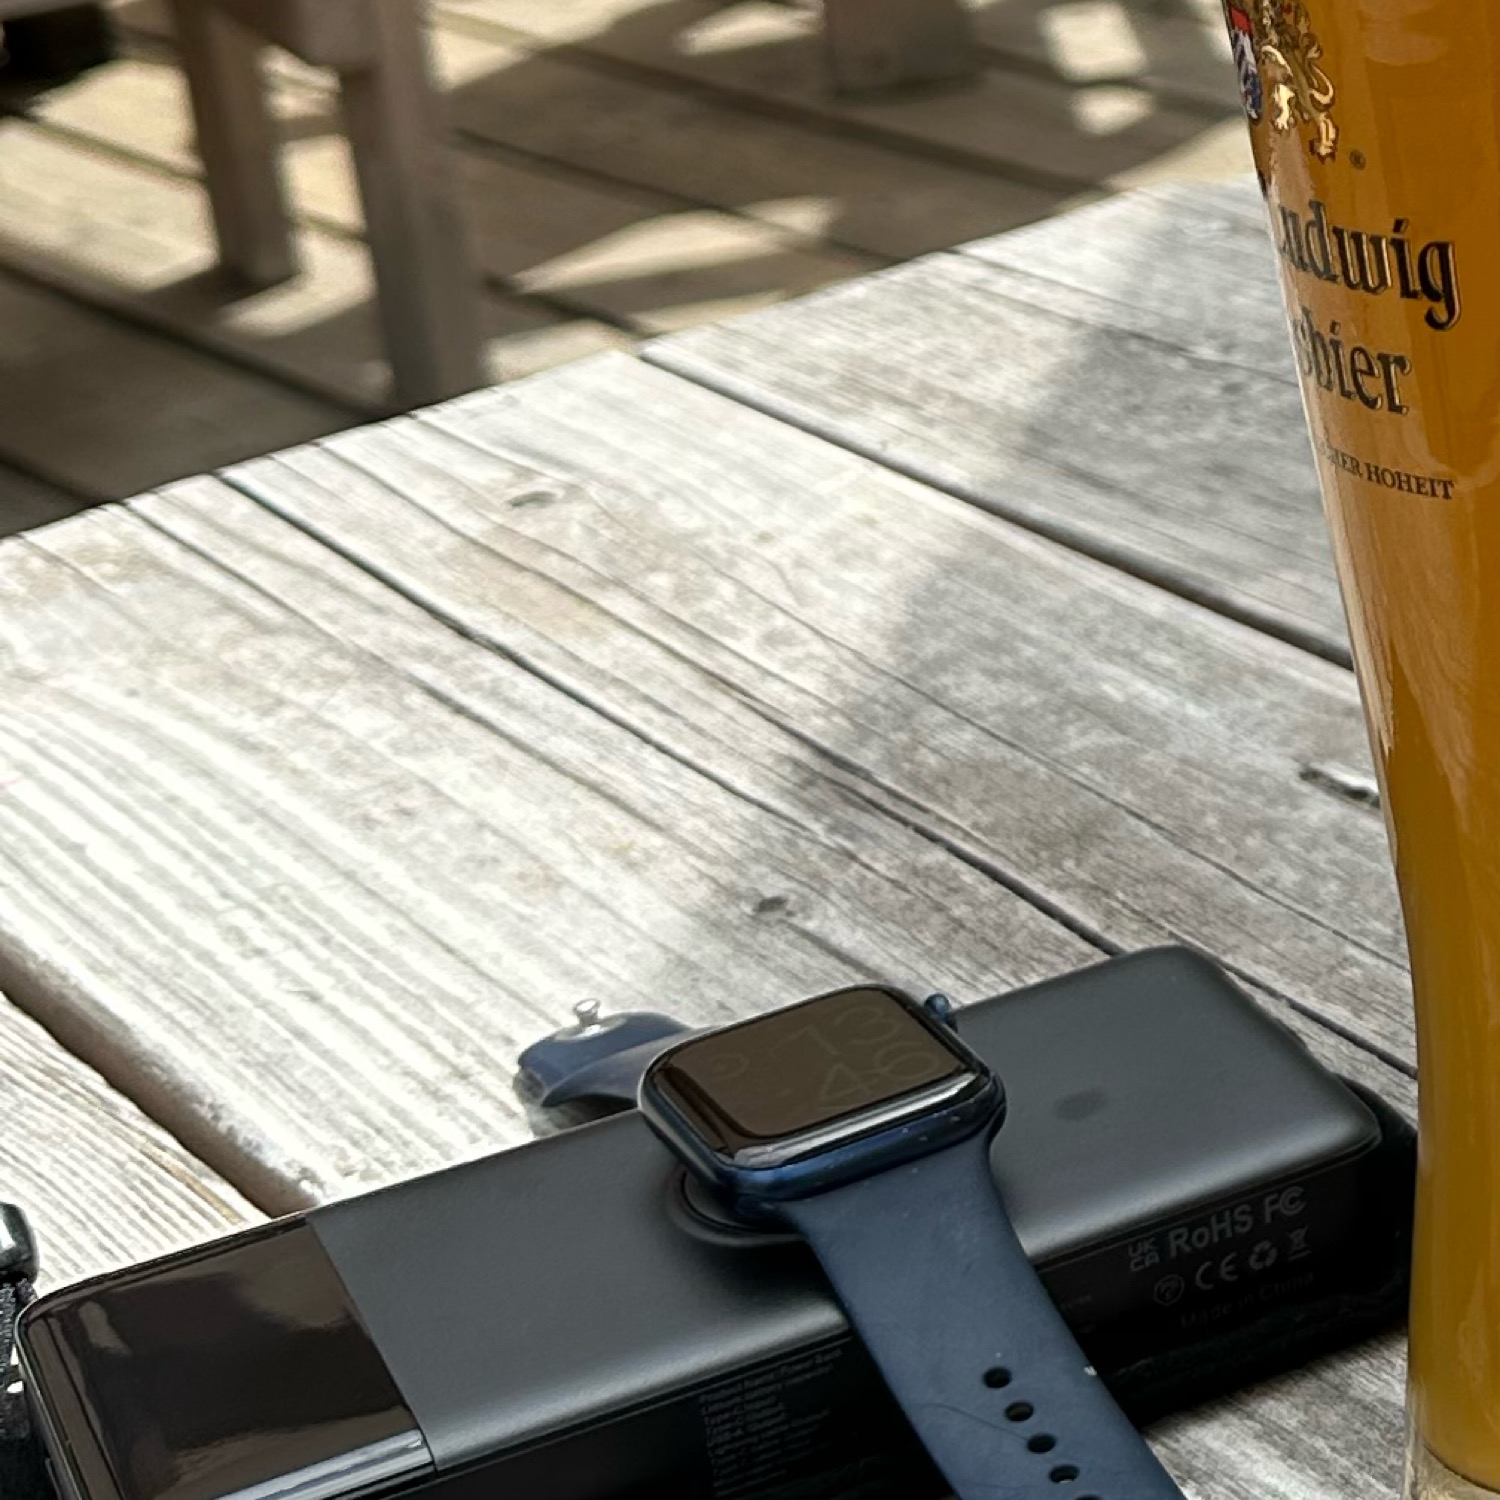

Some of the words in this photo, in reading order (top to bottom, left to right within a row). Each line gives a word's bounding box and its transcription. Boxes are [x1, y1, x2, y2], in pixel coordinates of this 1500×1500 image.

[1276, 198, 1461, 331] udwig
[1365, 462, 1455, 500] HOHEIT
[1168, 1203, 1255, 1260] RoHS
[1194, 1251, 1240, 1290] CE
